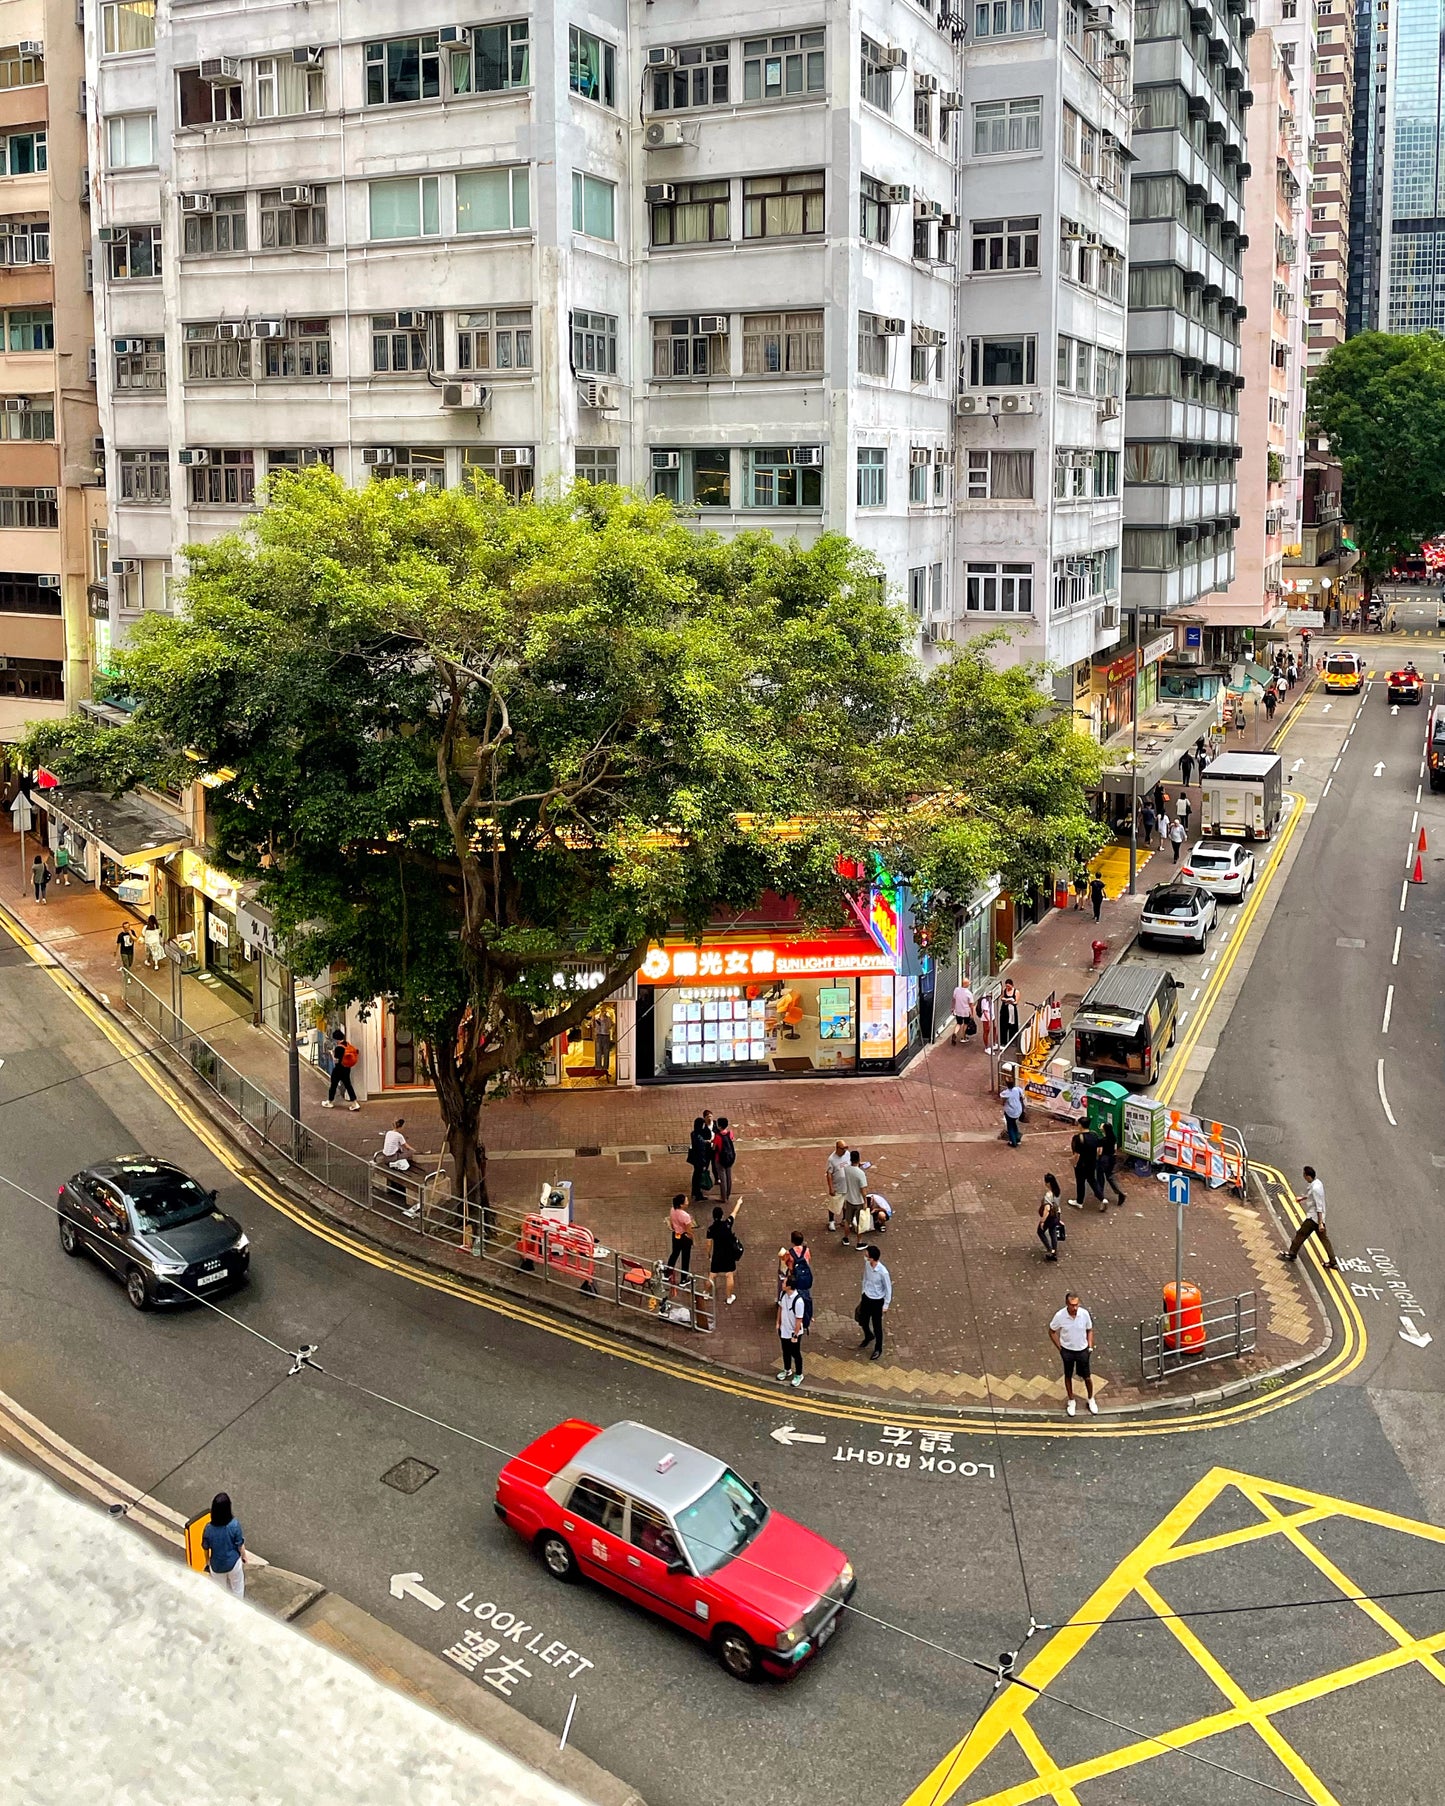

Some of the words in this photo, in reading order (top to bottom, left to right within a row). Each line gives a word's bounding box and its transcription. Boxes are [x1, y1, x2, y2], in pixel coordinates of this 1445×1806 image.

[776, 957, 833, 970] SUNLIGHT
[1366, 1247, 1401, 1277] LOOK
[1386, 1280, 1426, 1316] RIGHT
[879, 1425, 955, 1454] 望右
[832, 1446, 911, 1469] RIGHT
[918, 1455, 996, 1479] LOOK
[456, 1592, 532, 1643] LOOK
[524, 1632, 595, 1679] LEFT
[442, 1629, 533, 1696] 望左
